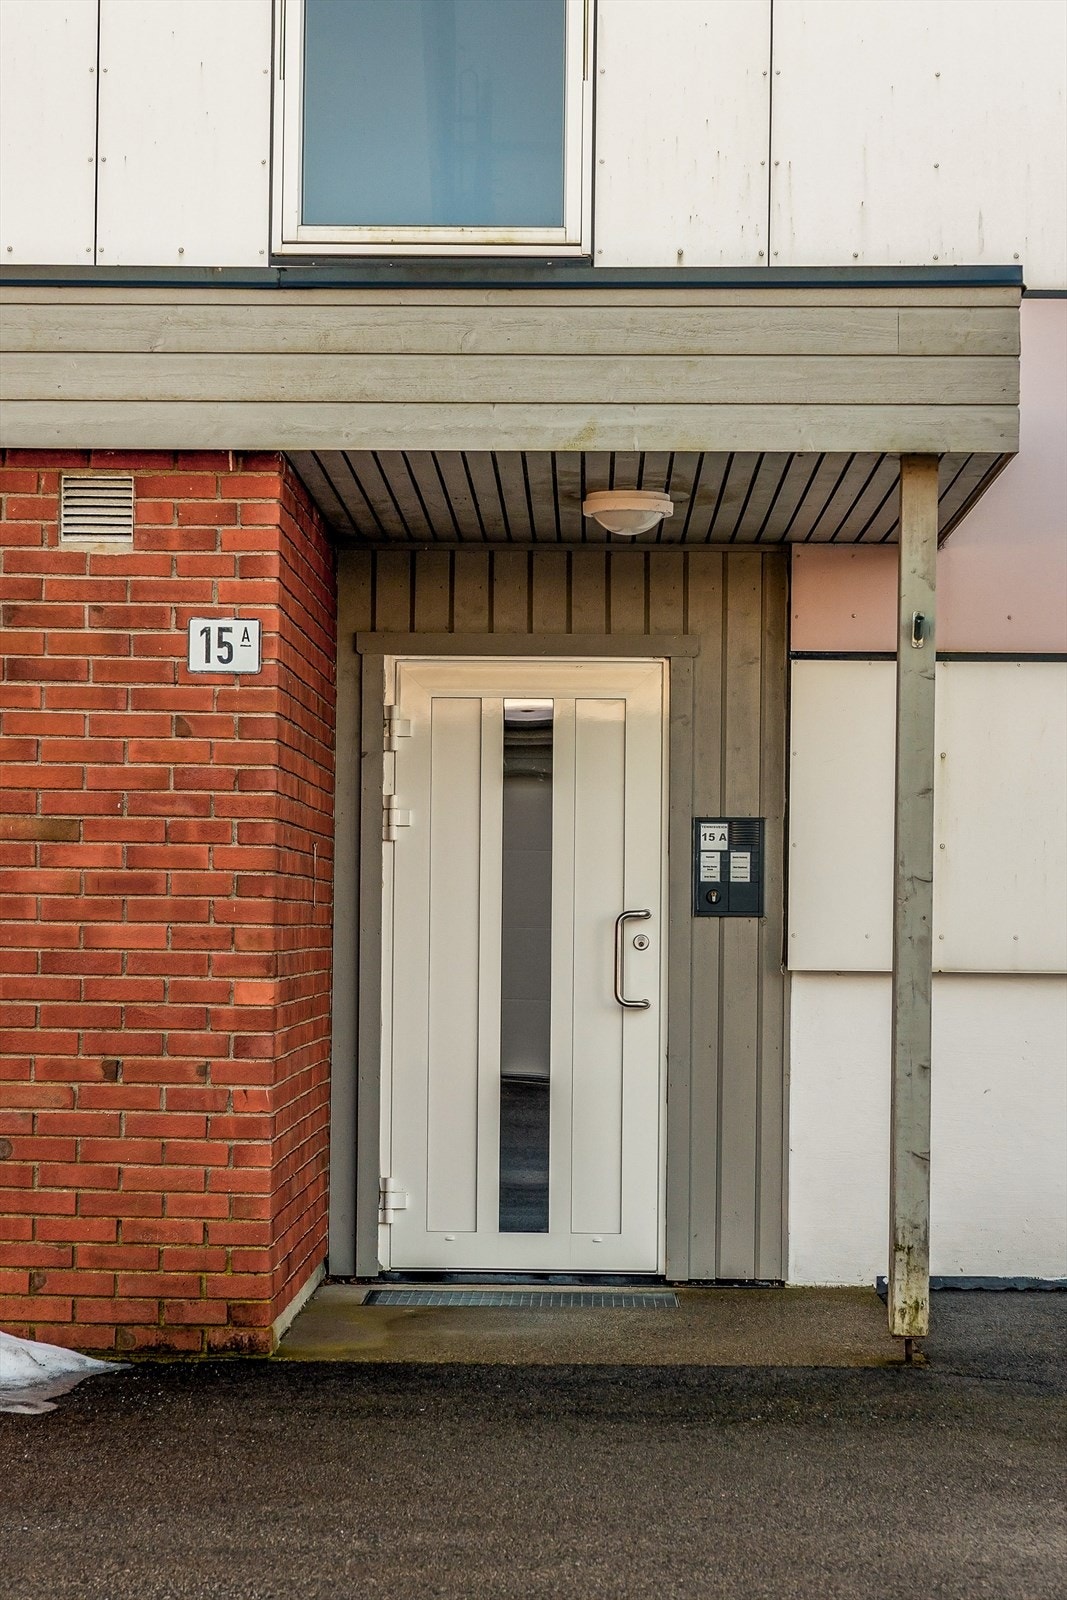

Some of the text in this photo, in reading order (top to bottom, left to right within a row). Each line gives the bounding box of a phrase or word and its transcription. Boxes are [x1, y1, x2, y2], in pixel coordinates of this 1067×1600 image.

[200, 626, 251, 665] 15 A
[702, 833, 727, 841] 15 A
